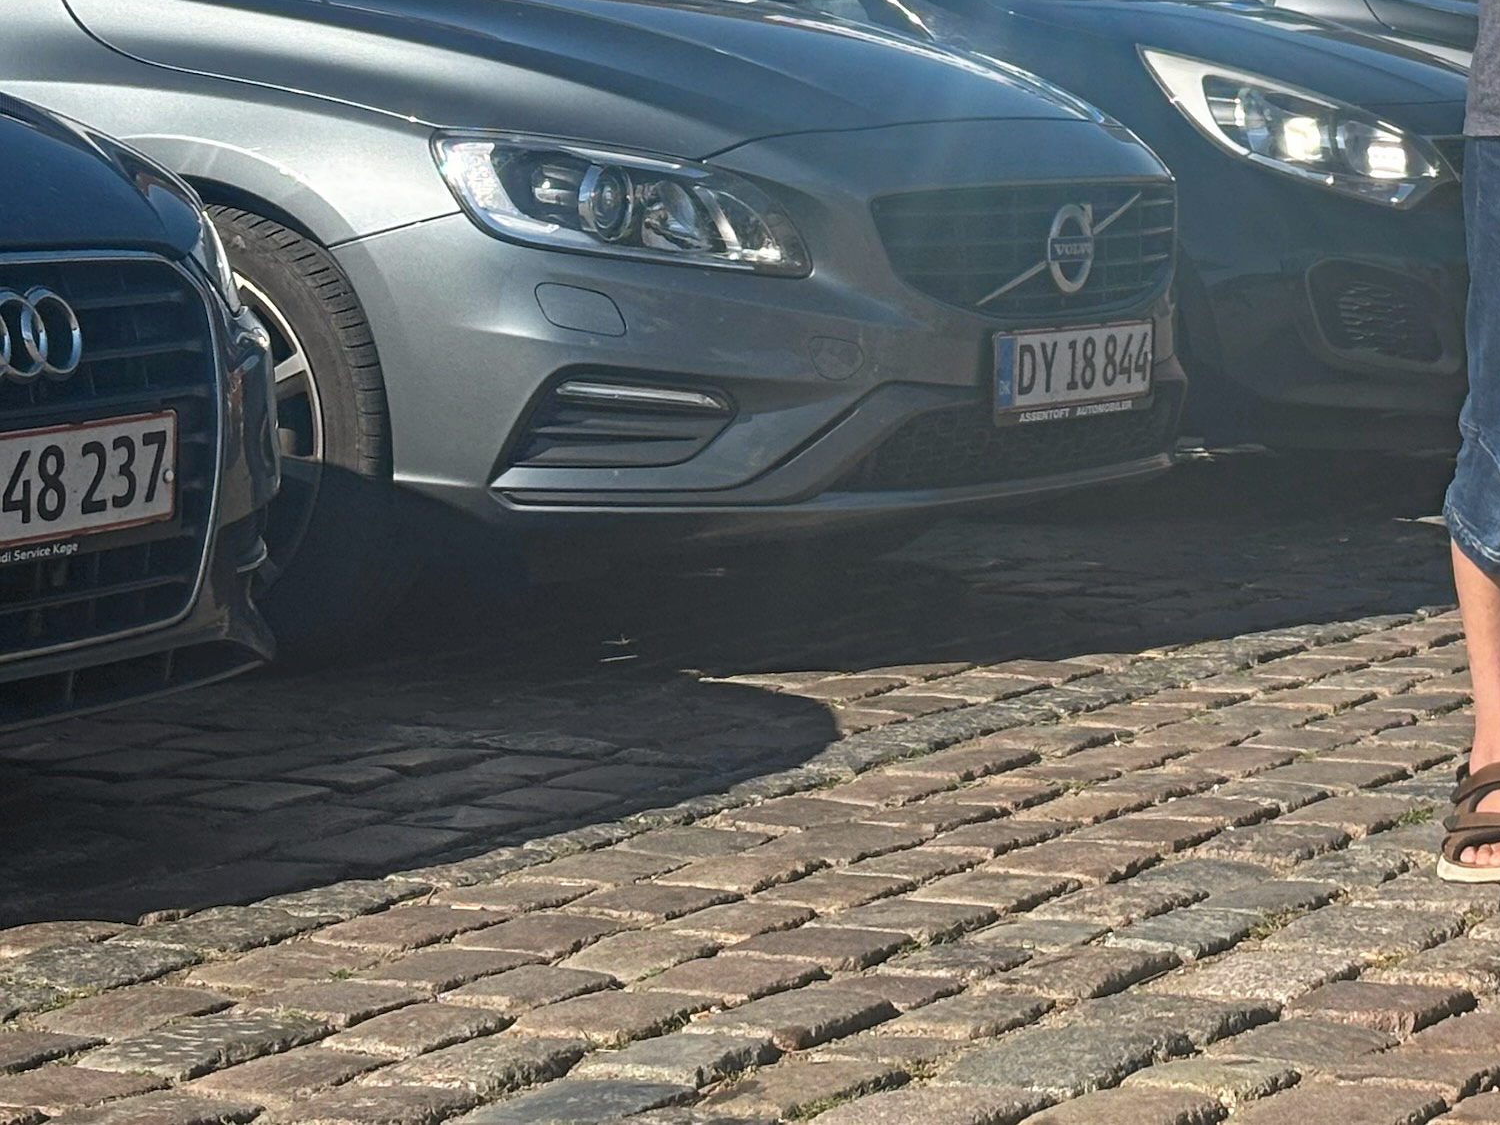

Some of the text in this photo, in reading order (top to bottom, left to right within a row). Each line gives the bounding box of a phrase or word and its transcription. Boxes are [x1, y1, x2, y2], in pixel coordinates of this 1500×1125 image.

[1017, 332, 1150, 396] DY 18 844
[1019, 400, 1133, 423] ASSENTOFT AUTOMOBILER
[2, 430, 167, 524] 48 237
[13, 547, 51, 562] Service
